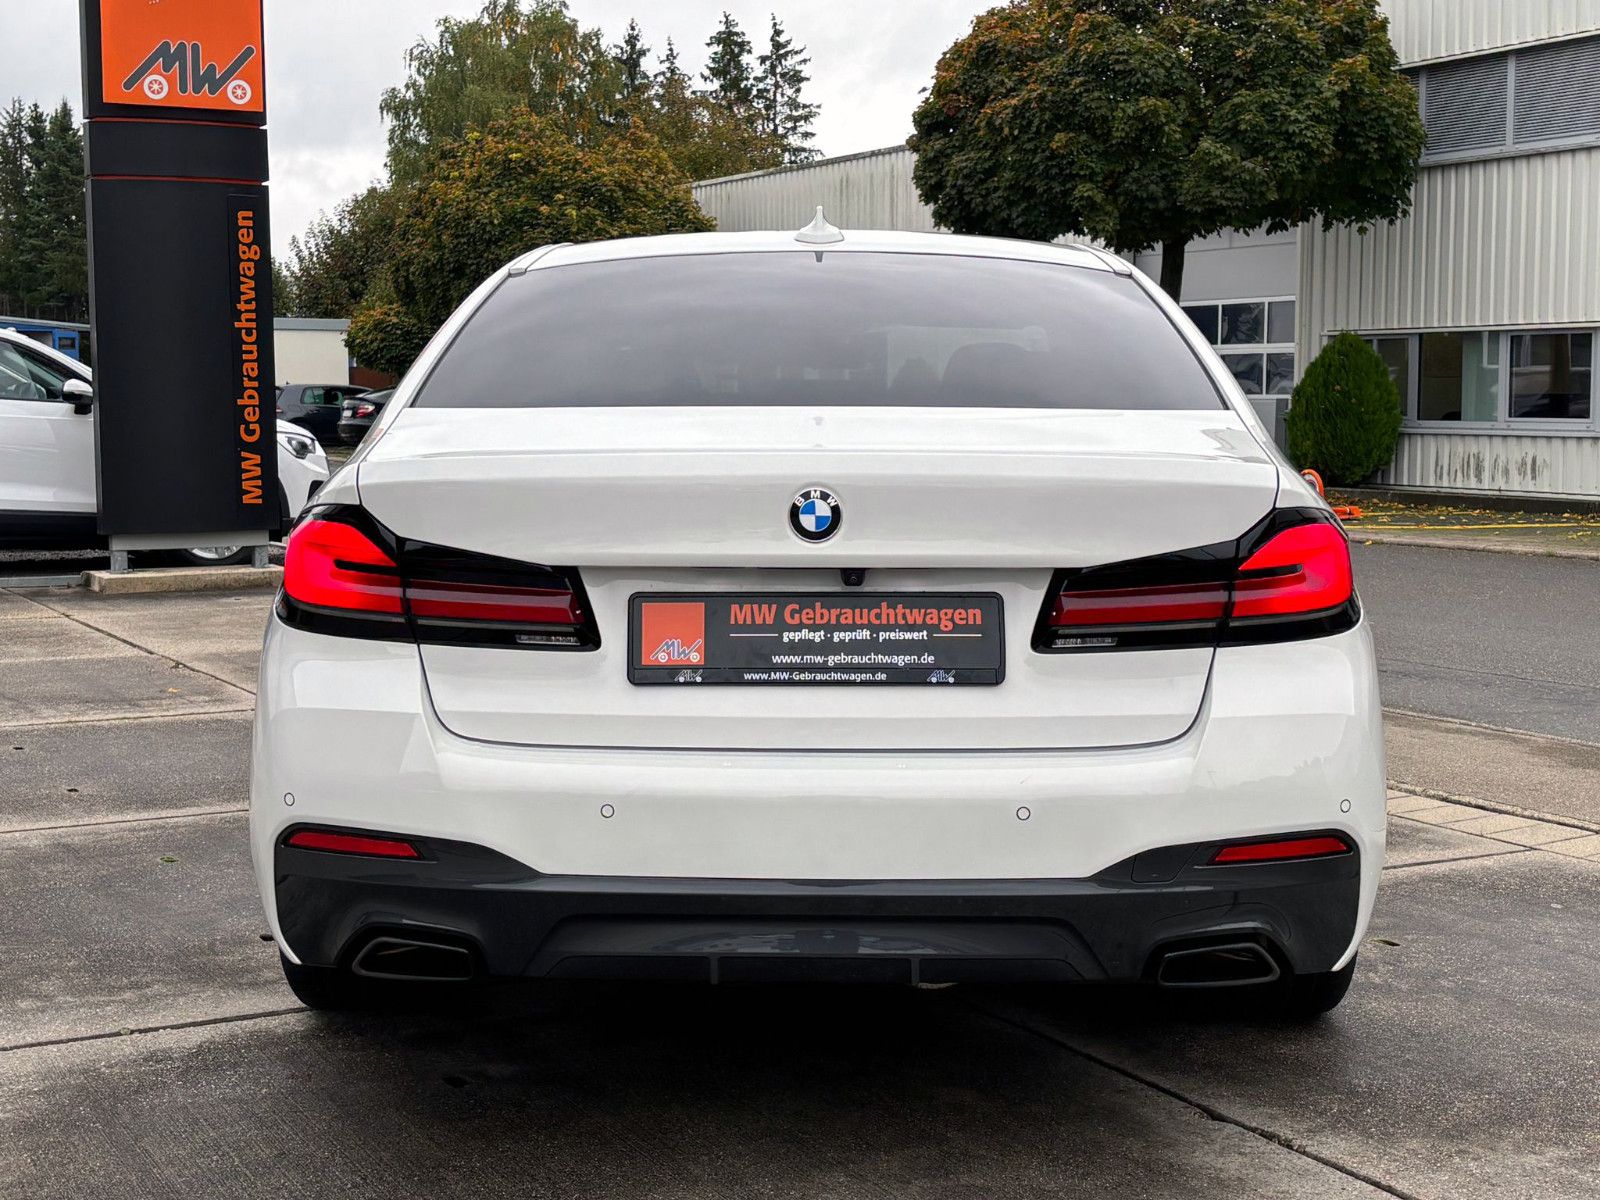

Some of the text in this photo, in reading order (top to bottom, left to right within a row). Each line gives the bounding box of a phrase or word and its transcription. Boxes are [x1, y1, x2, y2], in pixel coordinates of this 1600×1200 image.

[121, 39, 257, 97] MW
[234, 210, 262, 504] MW Gebrauchtwagen
[794, 490, 838, 507] BMW
[729, 601, 982, 632] MW Gebrauchtwagen
[782, 628, 928, 643] gepflegt geprüft preiswert
[650, 639, 702, 661] MW
[771, 652, 935, 667] www.mw-gebrauchtwagen.de
[743, 671, 887, 683] www.MW-Gebrauchtwagen.de
